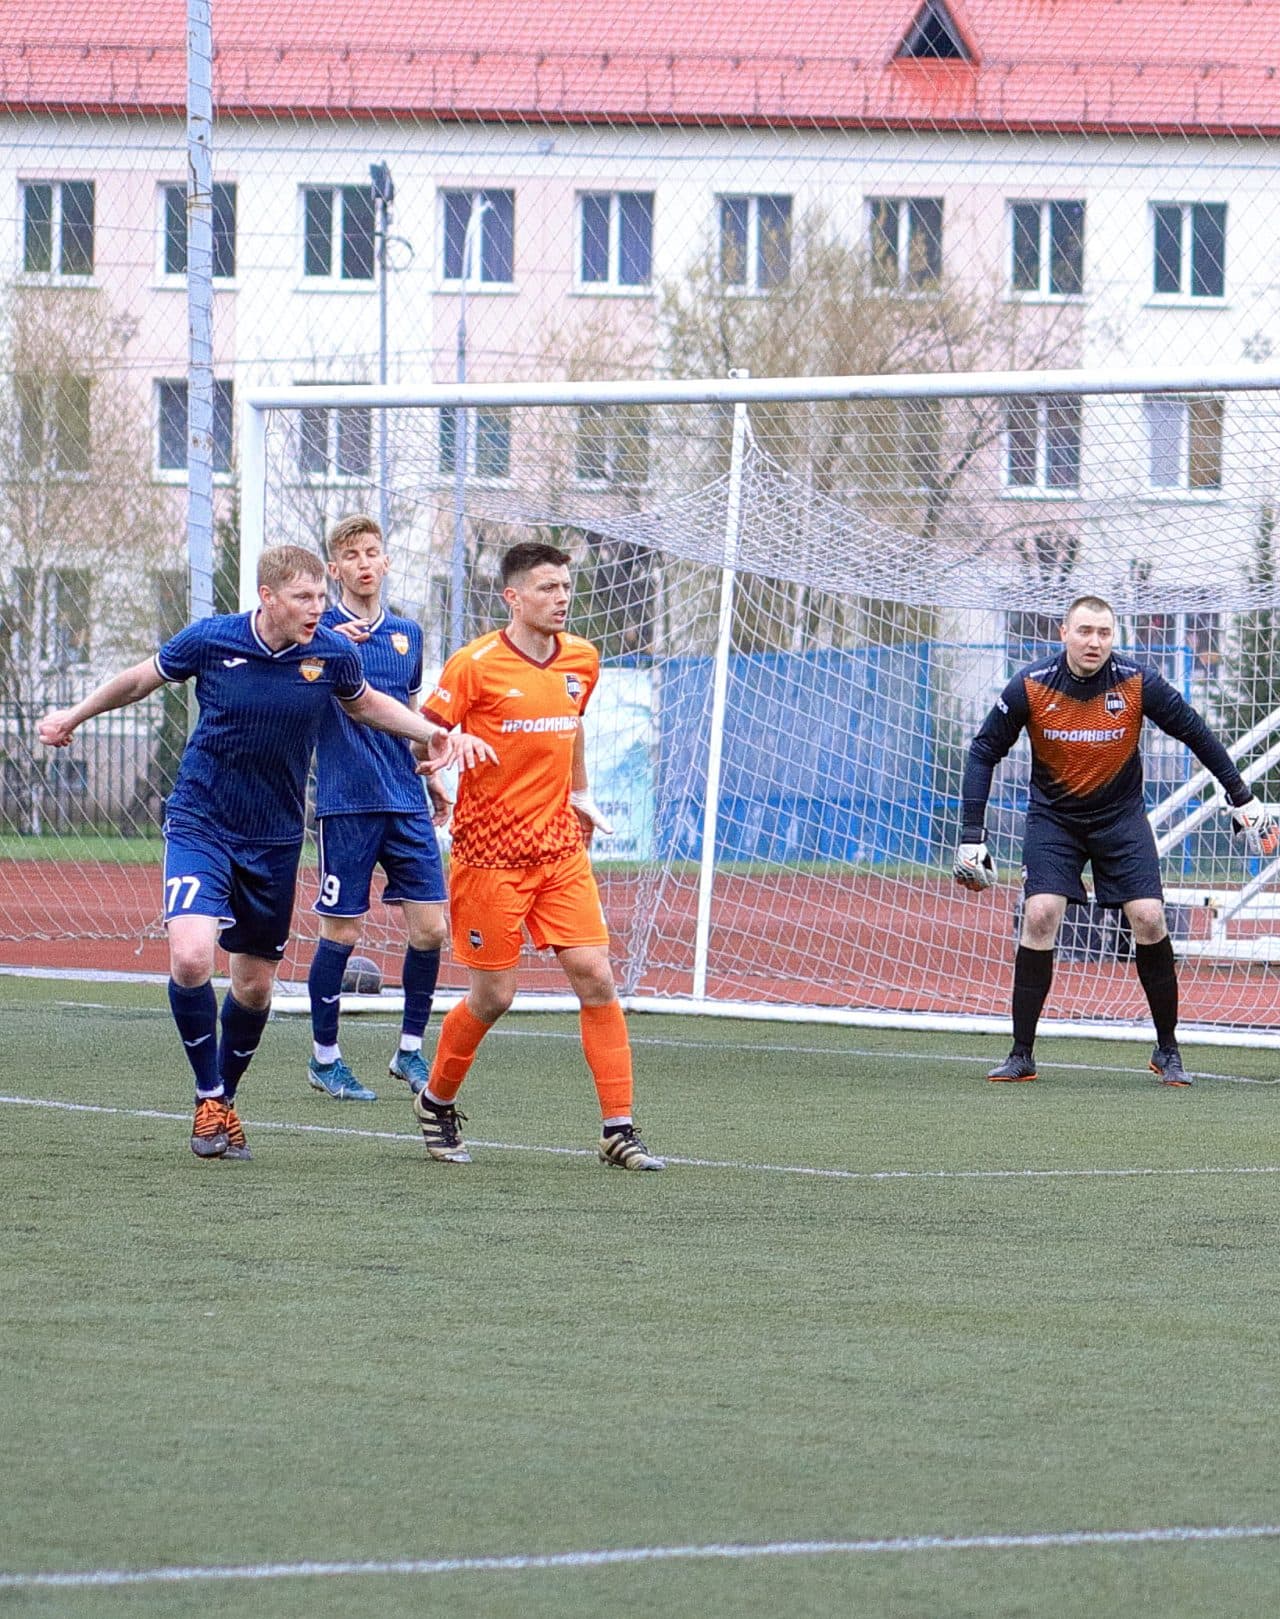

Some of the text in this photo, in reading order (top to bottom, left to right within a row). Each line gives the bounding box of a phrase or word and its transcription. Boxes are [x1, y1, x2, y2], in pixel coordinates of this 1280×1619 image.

[1043, 727, 1126, 742] ПРОДИНВЕСТ
[166, 876, 201, 913] 77
[321, 872, 341, 907] 9
